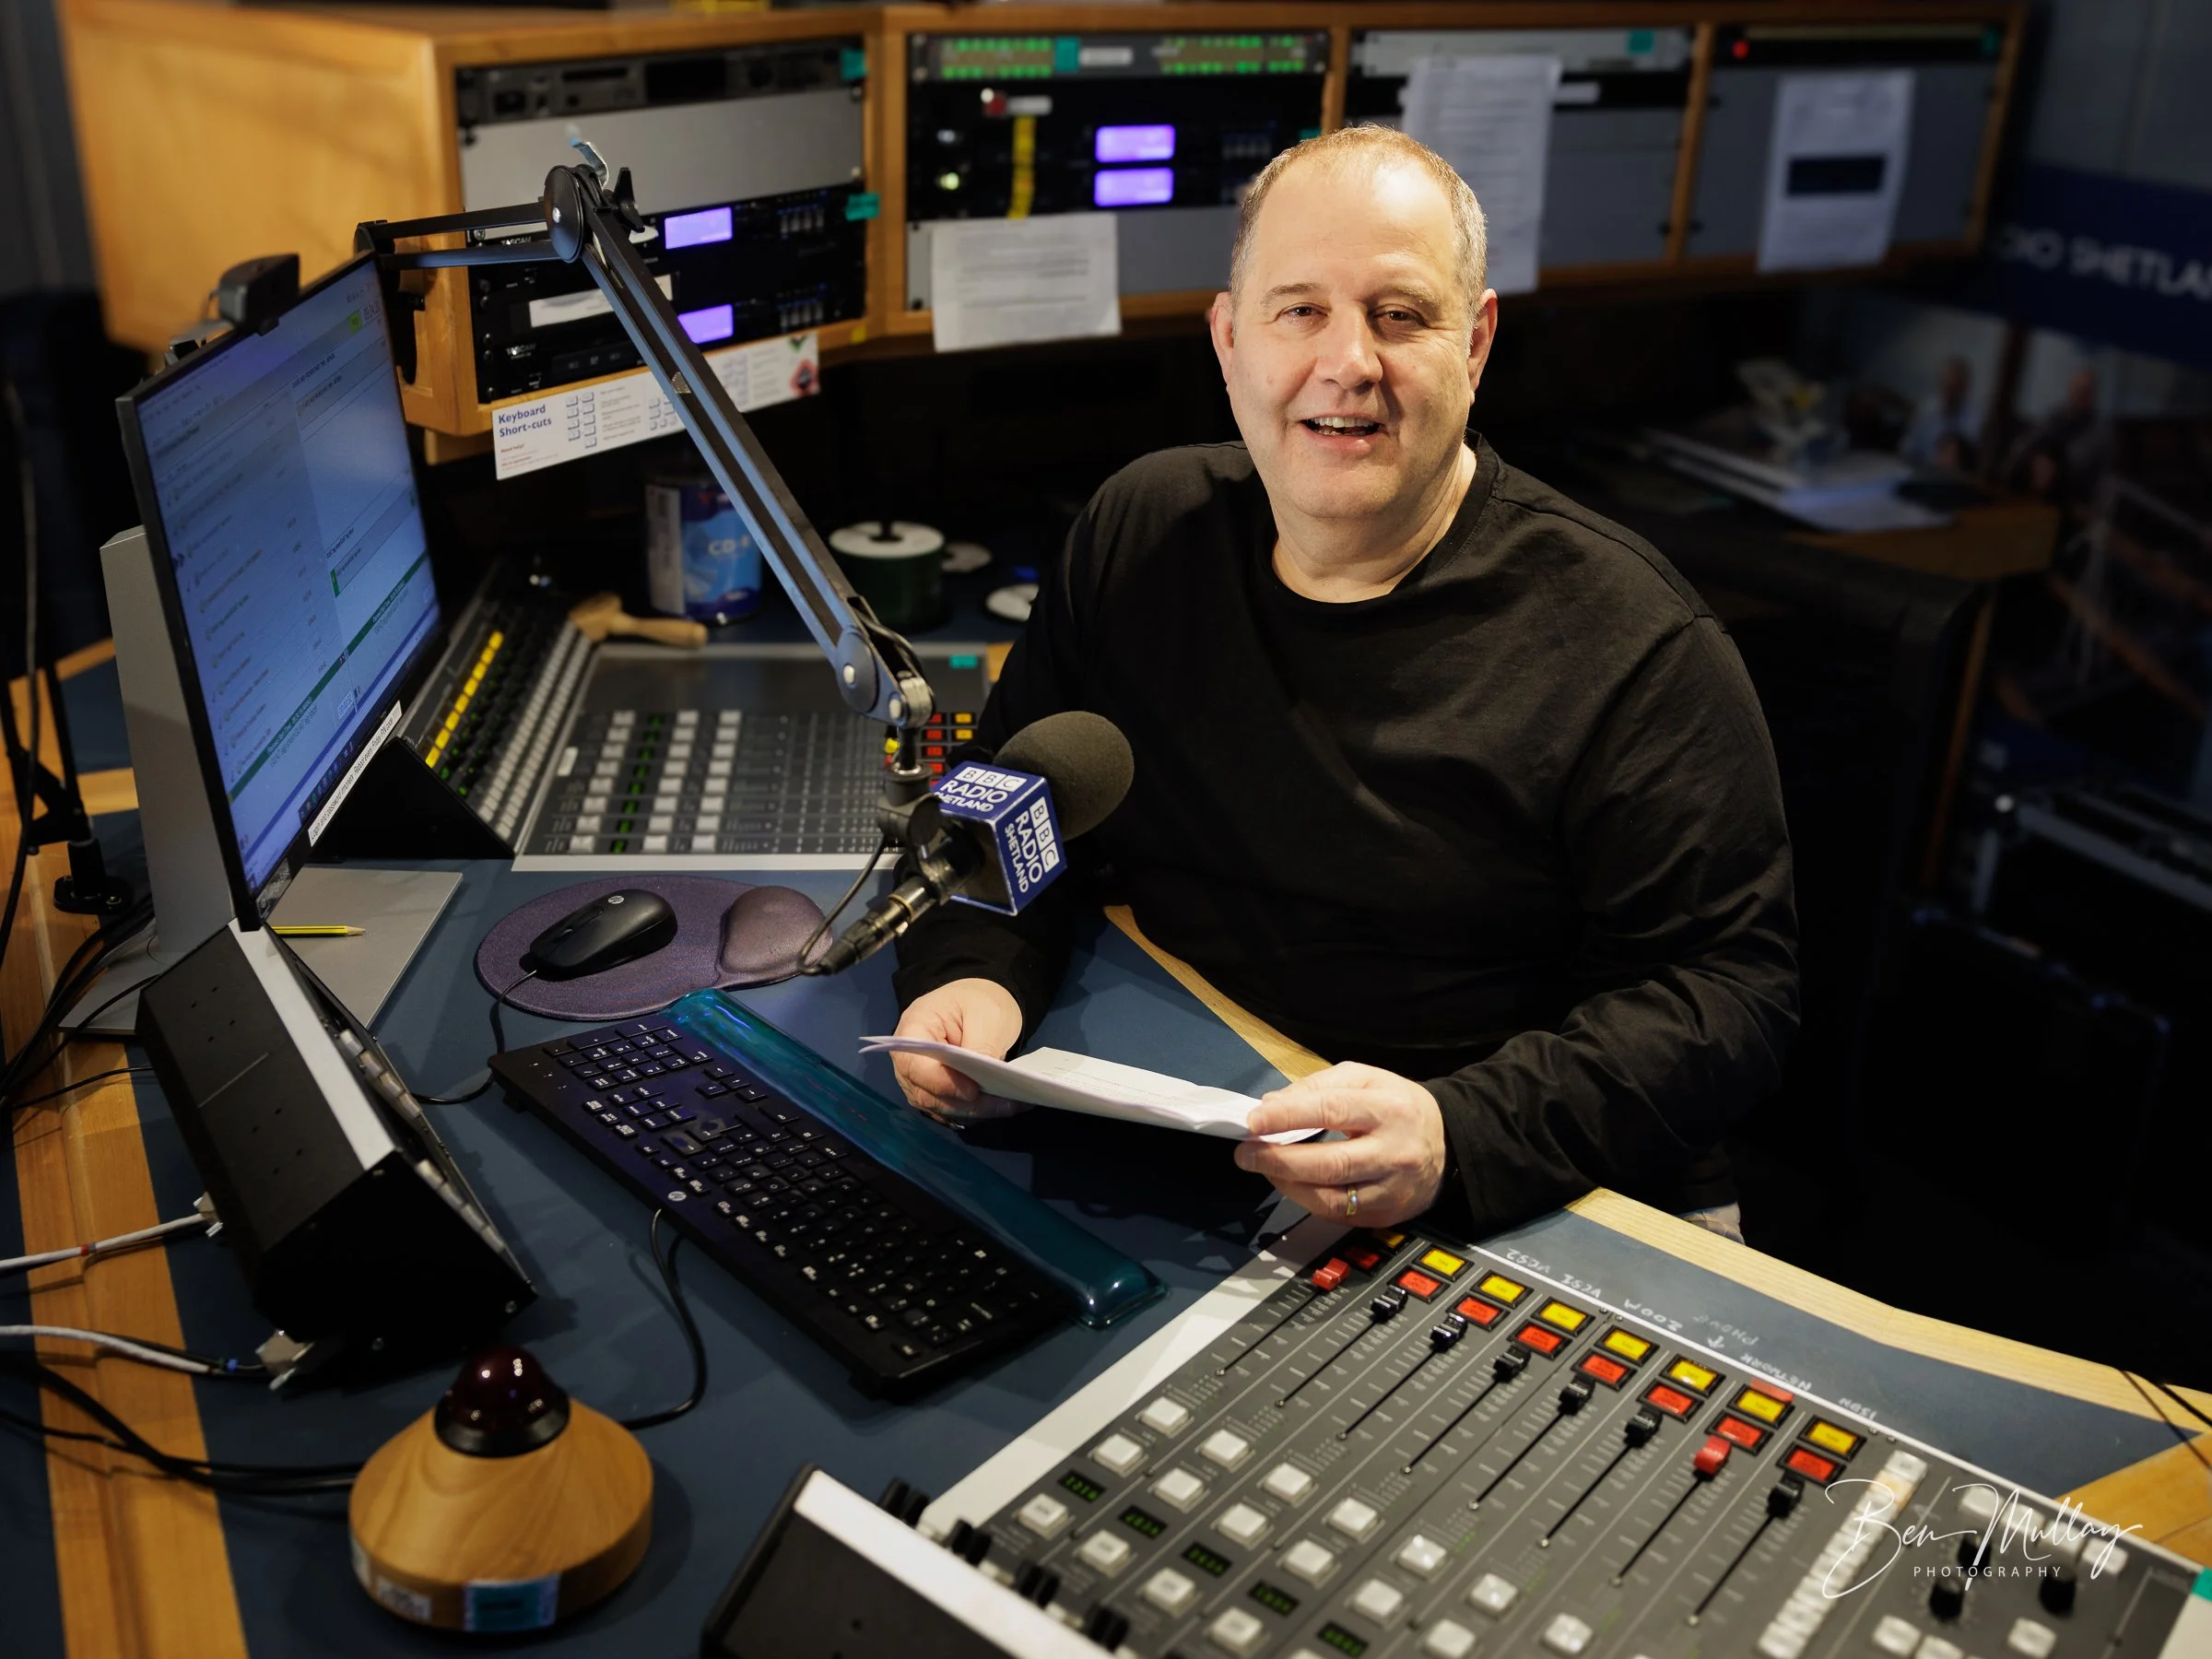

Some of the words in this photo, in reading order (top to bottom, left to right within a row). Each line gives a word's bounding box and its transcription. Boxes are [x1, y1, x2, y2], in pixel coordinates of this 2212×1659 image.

[2069, 234, 2212, 302] SHETLA
[499, 404, 546, 424] Keyboard
[500, 418, 552, 437] Short-cuts
[939, 780, 1008, 804] RADIO
[955, 767, 1028, 793] BBC
[1015, 810, 1043, 884] RADIO
[1030, 796, 1060, 873] BBC
[1005, 823, 1030, 893] SHETLAND
[1505, 1248, 1551, 1275] VCS2
[1623, 1299, 1684, 1333] ZOOM
[1740, 1353, 1812, 1393] NETWORK
